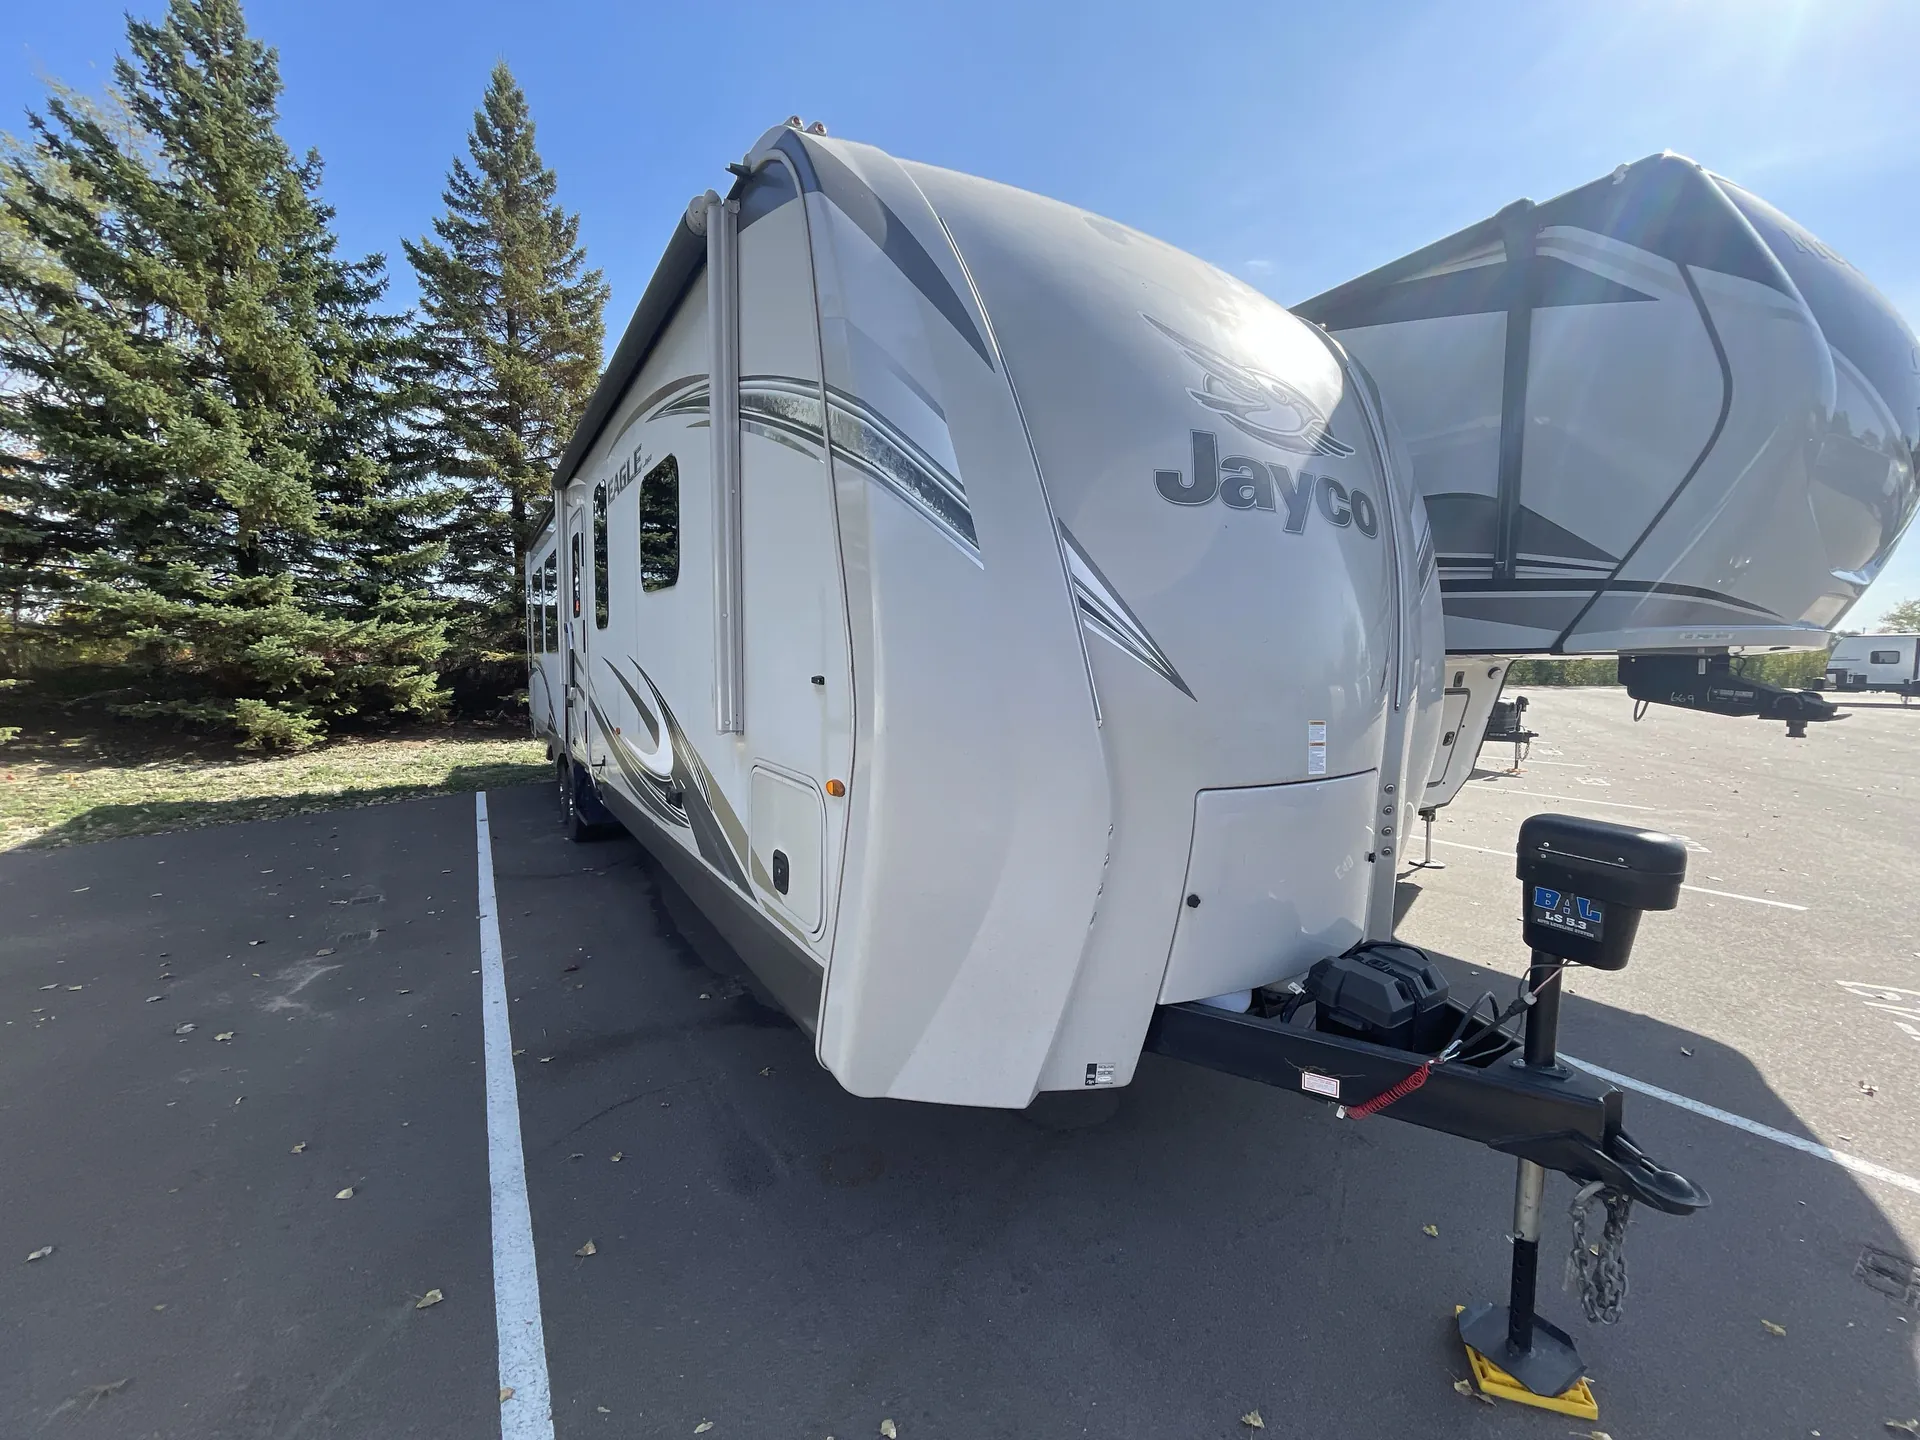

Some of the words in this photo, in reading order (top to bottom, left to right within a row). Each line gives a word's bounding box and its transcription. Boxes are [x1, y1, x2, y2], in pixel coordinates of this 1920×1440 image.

[608, 443, 643, 506] EAGLE
[1153, 429, 1378, 538] Jayco
[1670, 691, 1694, 705] 669
[1545, 911, 1563, 923] LS
[1566, 917, 1587, 930] 5.3
